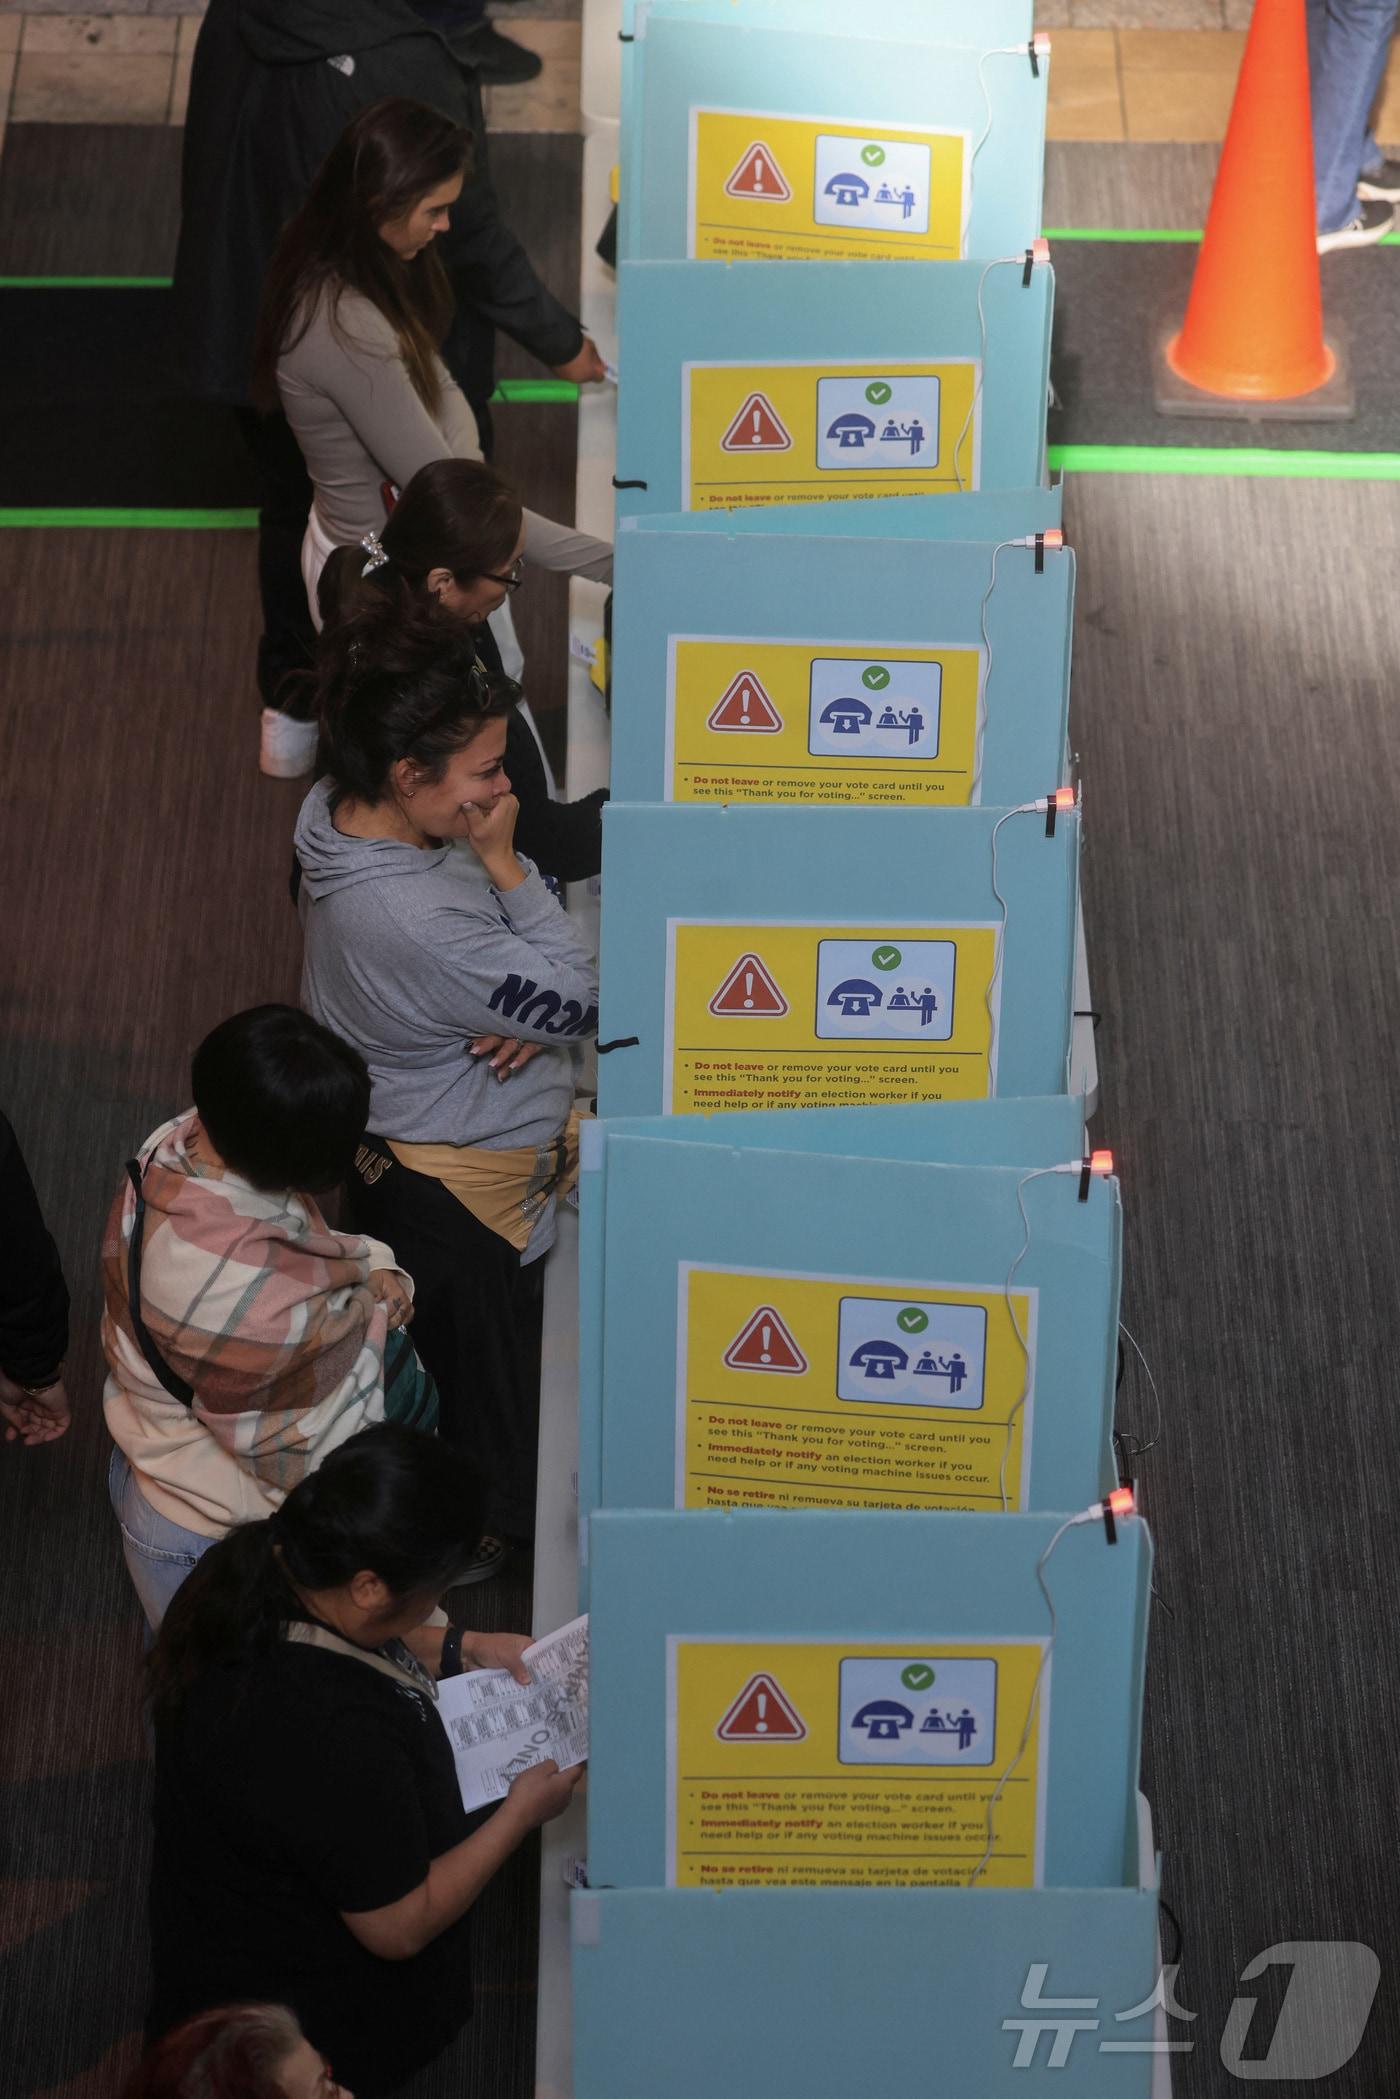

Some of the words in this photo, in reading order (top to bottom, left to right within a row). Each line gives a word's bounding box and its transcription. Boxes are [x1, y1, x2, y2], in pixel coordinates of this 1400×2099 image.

[744, 494, 772, 502] leave
[852, 492, 874, 500] vote
[693, 776, 709, 785] Do
[711, 776, 729, 785] not
[731, 777, 760, 786] leave
[776, 780, 817, 788] remove
[819, 781, 843, 790] your
[846, 780, 869, 789] vote
[872, 781, 896, 790] card
[898, 782, 923, 791] until
[925, 784, 945, 792] you
[693, 787, 711, 795] see
[714, 786, 734, 796] this
[777, 790, 797, 800] you
[799, 790, 815, 798] for
[868, 793, 906, 801] screen.
[694, 1062, 710, 1071] Do
[713, 1062, 732, 1071] not
[734, 1062, 764, 1072] leave
[767, 1064, 780, 1072] or
[782, 1064, 824, 1073] remove
[827, 1066, 853, 1075] your
[855, 1065, 880, 1074] vote
[882, 1065, 908, 1074] card
[910, 1065, 936, 1074] until
[938, 1067, 959, 1076] you
[694, 1073, 713, 1082] see
[716, 1072, 736, 1082] this
[783, 1076, 803, 1084] you
[806, 1074, 823, 1084] for
[878, 1077, 918, 1085] screen.
[694, 1088, 765, 1099] Immediately
[767, 1089, 801, 1100] notify
[821, 1090, 866, 1100] election
[869, 1091, 907, 1100] worker
[910, 1091, 919, 1100] if
[921, 1092, 942, 1102] you
[693, 1100, 721, 1109] need
[723, 1100, 748, 1110] help
[751, 1101, 764, 1109] or
[767, 1100, 776, 1109] if
[777, 1102, 797, 1110] any
[708, 1415, 725, 1424] Do
[727, 1418, 748, 1426] not
[751, 1419, 782, 1429] leave
[785, 1423, 798, 1431] or
[801, 1424, 846, 1435] remove
[849, 1428, 876, 1438] your
[879, 1430, 906, 1440] vote
[909, 1432, 935, 1441] card
[939, 1434, 966, 1443] until
[969, 1436, 991, 1445] you
[708, 1427, 729, 1436] see
[731, 1428, 753, 1438] this
[802, 1436, 824, 1446] you
[826, 1436, 844, 1446] for
[904, 1443, 947, 1454] screen.
[708, 1443, 783, 1458] Immediately
[786, 1451, 822, 1462] notify
[825, 1454, 840, 1462] an
[843, 1454, 892, 1466] election
[895, 1458, 936, 1469] worker
[939, 1460, 948, 1469] if
[950, 1463, 973, 1472] you
[708, 1454, 737, 1464] need
[740, 1457, 766, 1468] help
[769, 1460, 783, 1468] or
[785, 1460, 795, 1469] if
[796, 1463, 818, 1472] any
[821, 1464, 859, 1476] voting
[862, 1467, 913, 1479] machine
[916, 1470, 951, 1481] issues
[954, 1474, 990, 1484] occur.
[707, 1486, 725, 1496] No
[726, 1489, 740, 1497] se
[742, 1490, 776, 1500] retire
[778, 1493, 790, 1501] ni
[793, 1495, 844, 1506] remueva
[846, 1499, 860, 1508] su
[863, 1500, 902, 1511] tarjeta
[905, 1502, 921, 1511] de
[707, 1497, 738, 1508] hasta
[701, 1791, 719, 1800] Do
[722, 1791, 744, 1800] not
[746, 1791, 780, 1800] leave
[784, 1792, 798, 1800] or
[801, 1792, 848, 1800] remove
[852, 1792, 879, 1802] your
[884, 1792, 913, 1801] vote
[916, 1792, 944, 1802] card
[947, 1792, 976, 1802] until
[701, 1803, 722, 1812] see
[726, 1802, 749, 1812] this
[801, 1804, 824, 1813] you
[828, 1802, 846, 1812] for
[701, 1819, 781, 1829] Immediately
[784, 1819, 823, 1829] notify
[846, 1820, 897, 1829] election
[900, 1820, 945, 1830] worker
[948, 1820, 957, 1830] if
[960, 1822, 984, 1831] you
[700, 1831, 732, 1840] need
[736, 1831, 763, 1840] help
[766, 1832, 780, 1840] or
[784, 1830, 793, 1840] if
[796, 1832, 818, 1841] any
[822, 1832, 862, 1842] voting
[866, 1832, 920, 1842] machine
[924, 1832, 961, 1842] issues
[700, 1864, 718, 1874] No
[722, 1866, 736, 1874] se
[738, 1864, 774, 1874] retire
[777, 1866, 788, 1874] ni
[792, 1866, 846, 1876] remueva
[850, 1868, 864, 1876] su
[868, 1867, 909, 1877] tarjeta
[912, 1867, 929, 1876] de
[700, 1876, 734, 1886] hasta
[737, 1878, 760, 1887] que
[766, 1878, 787, 1886] vea
[790, 1878, 816, 1886] este
[820, 1878, 873, 1888] mensaje
[876, 1880, 890, 1888] en
[895, 1878, 906, 1888] la
[910, 1878, 961, 1888] pantalla
